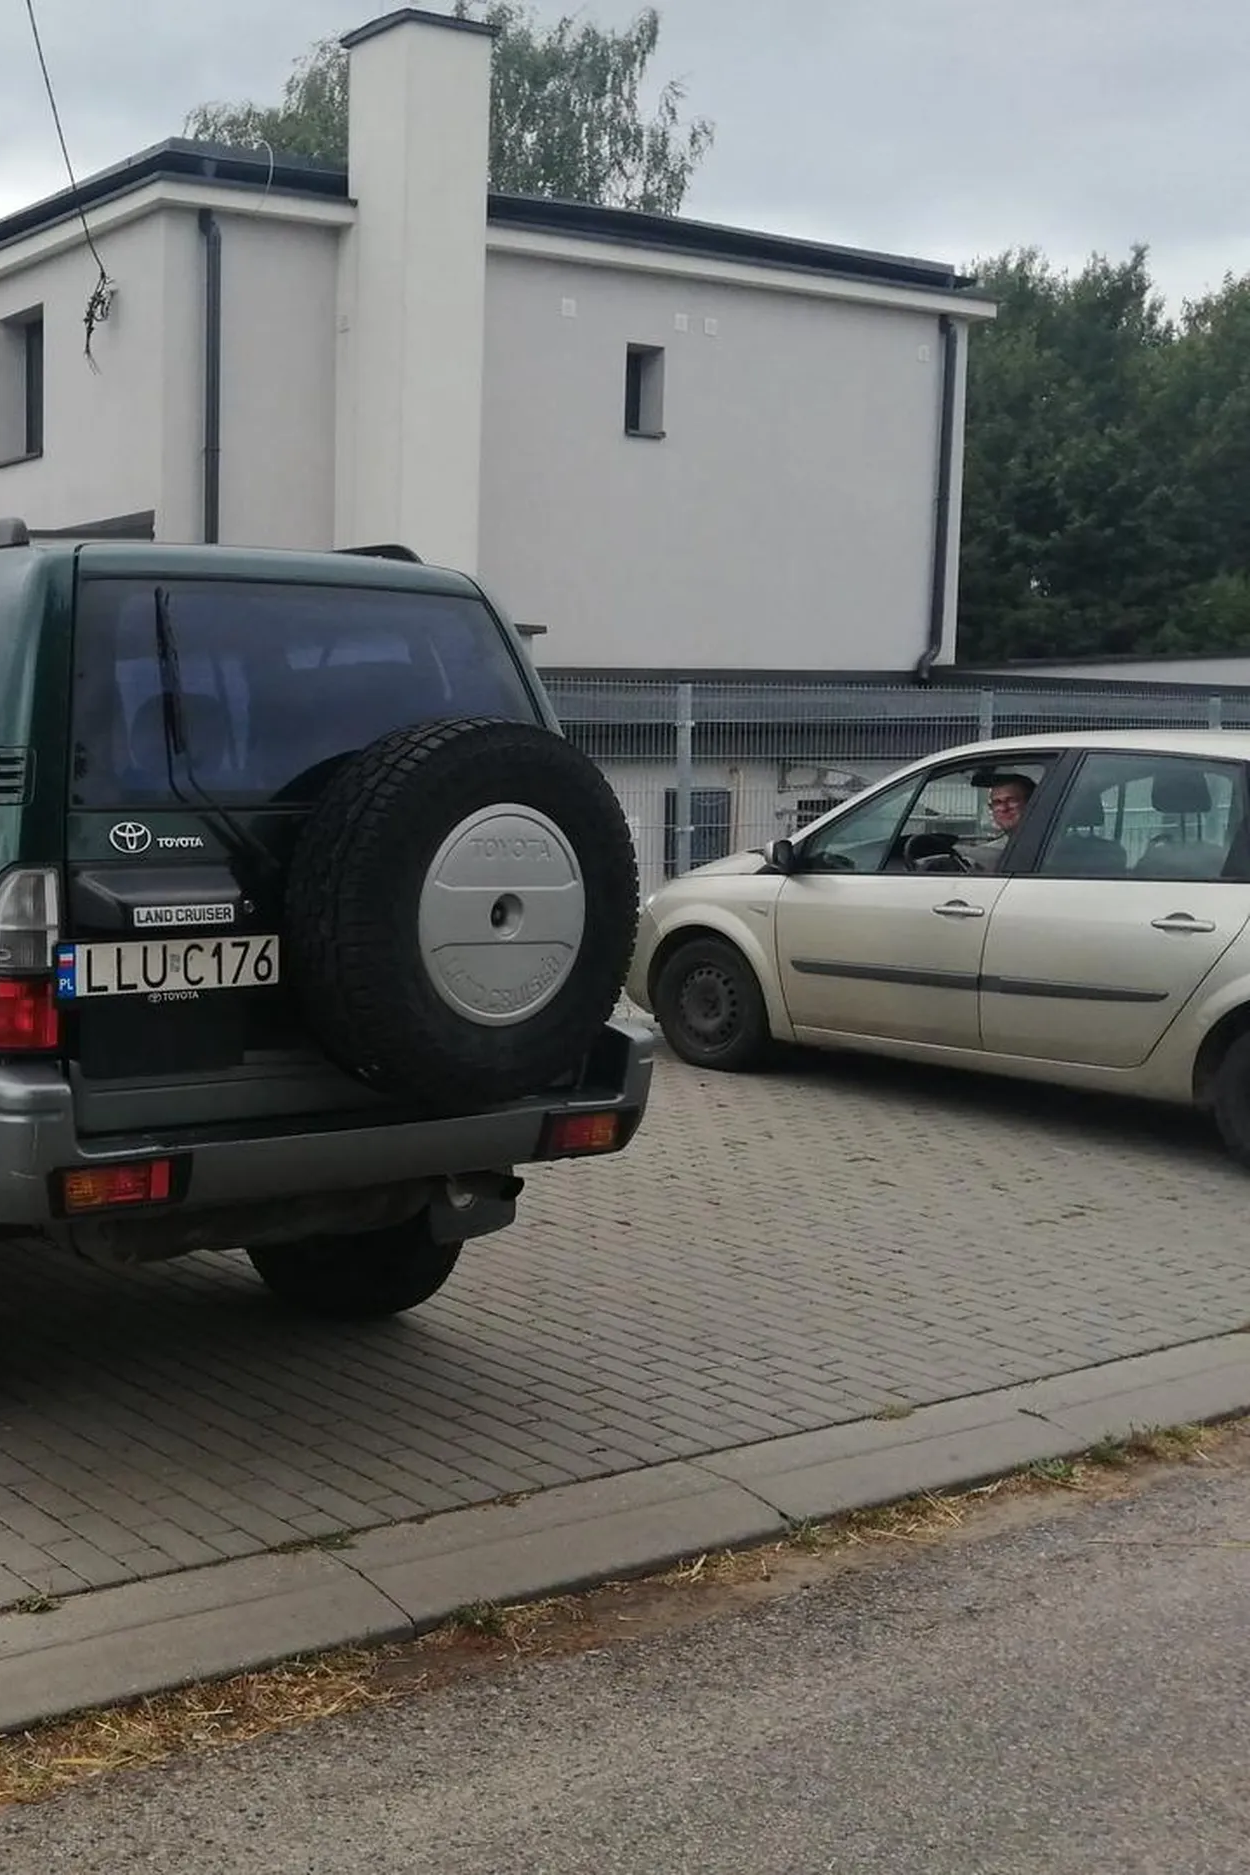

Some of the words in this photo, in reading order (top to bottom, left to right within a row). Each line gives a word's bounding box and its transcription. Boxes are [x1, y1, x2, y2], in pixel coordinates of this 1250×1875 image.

[156, 837, 204, 849] TOYOTA
[468, 837, 552, 860] TOYOTA
[136, 908, 173, 924] LAND
[175, 906, 232, 922] CRUISER
[85, 944, 168, 993] LLU
[183, 939, 273, 986] C176
[59, 978, 74, 991] PL
[162, 990, 199, 1001] TOYOTA
